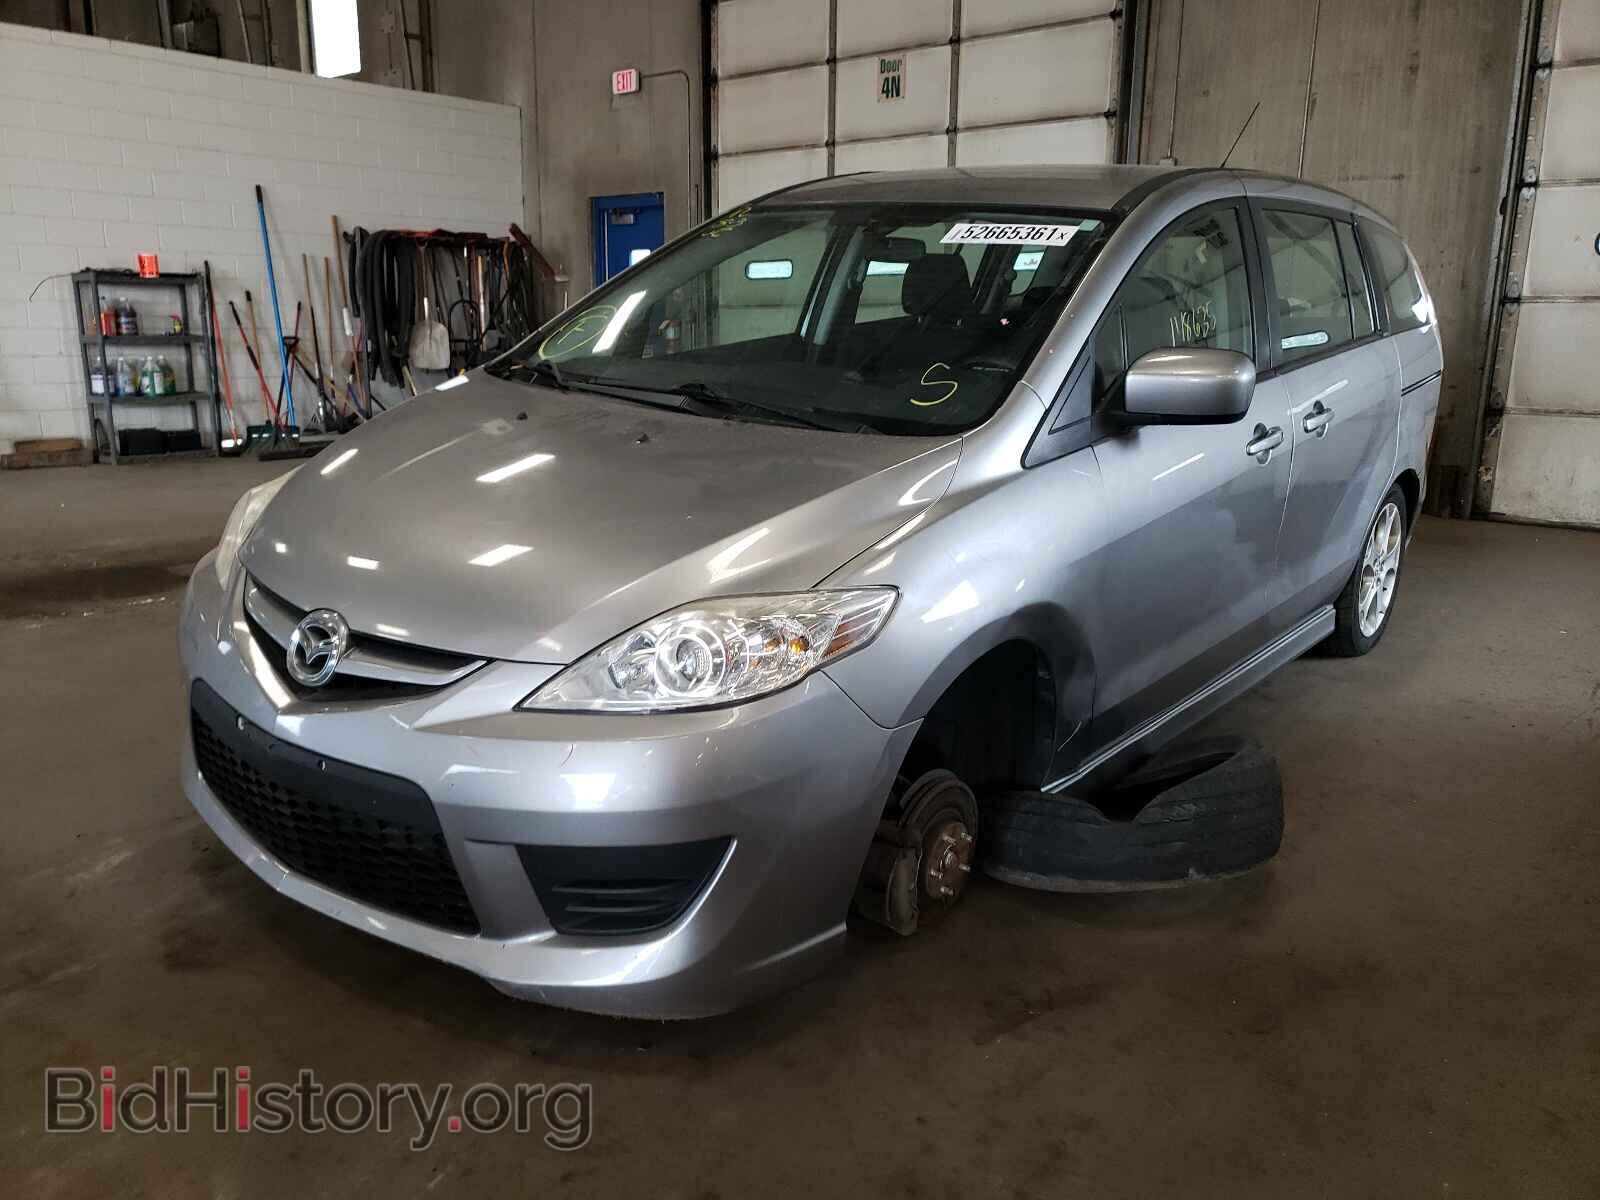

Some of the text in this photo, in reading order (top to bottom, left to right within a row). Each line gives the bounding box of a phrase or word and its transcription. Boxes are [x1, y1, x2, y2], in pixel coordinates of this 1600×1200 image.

[880, 58, 902, 74] Door
[616, 71, 633, 91] EXIT
[881, 75, 901, 100] 4N
